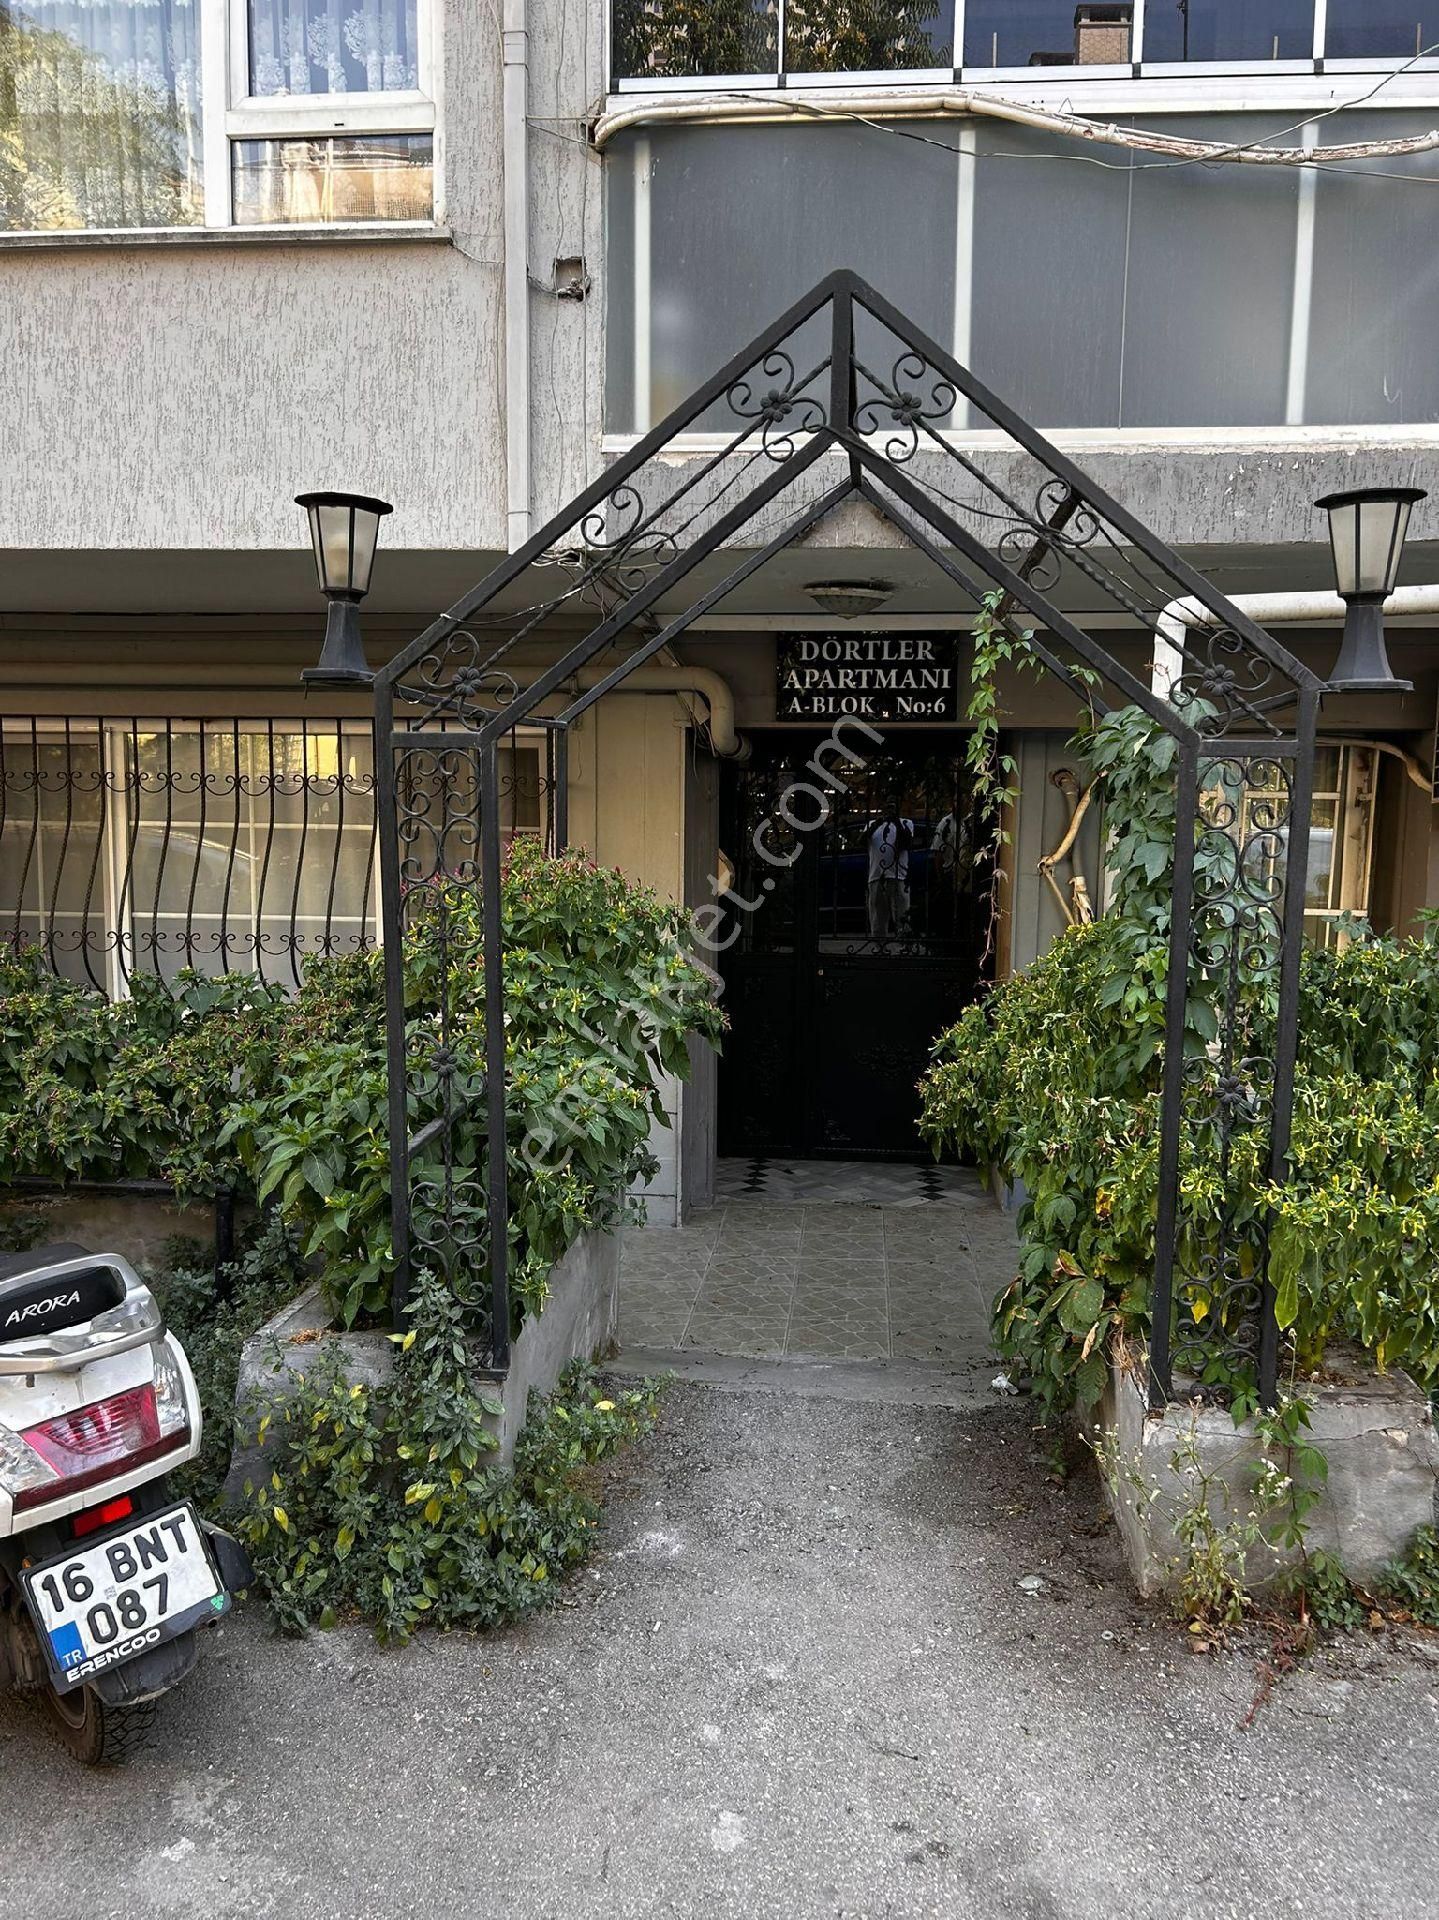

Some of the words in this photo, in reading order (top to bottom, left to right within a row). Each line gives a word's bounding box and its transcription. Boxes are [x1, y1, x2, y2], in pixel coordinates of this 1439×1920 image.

[799, 636, 936, 661] DÖRTLER
[782, 668, 952, 689] APARTMANI
[788, 696, 875, 714] A-BLOK
[897, 696, 946, 714] No:6
[4, 1290, 81, 1328] ARORA
[41, 1562, 94, 1613] 16
[105, 1513, 188, 1584] BNT
[86, 1572, 170, 1645] 087
[62, 1649, 84, 1667] TR
[66, 1628, 161, 1683] ERENCOO
